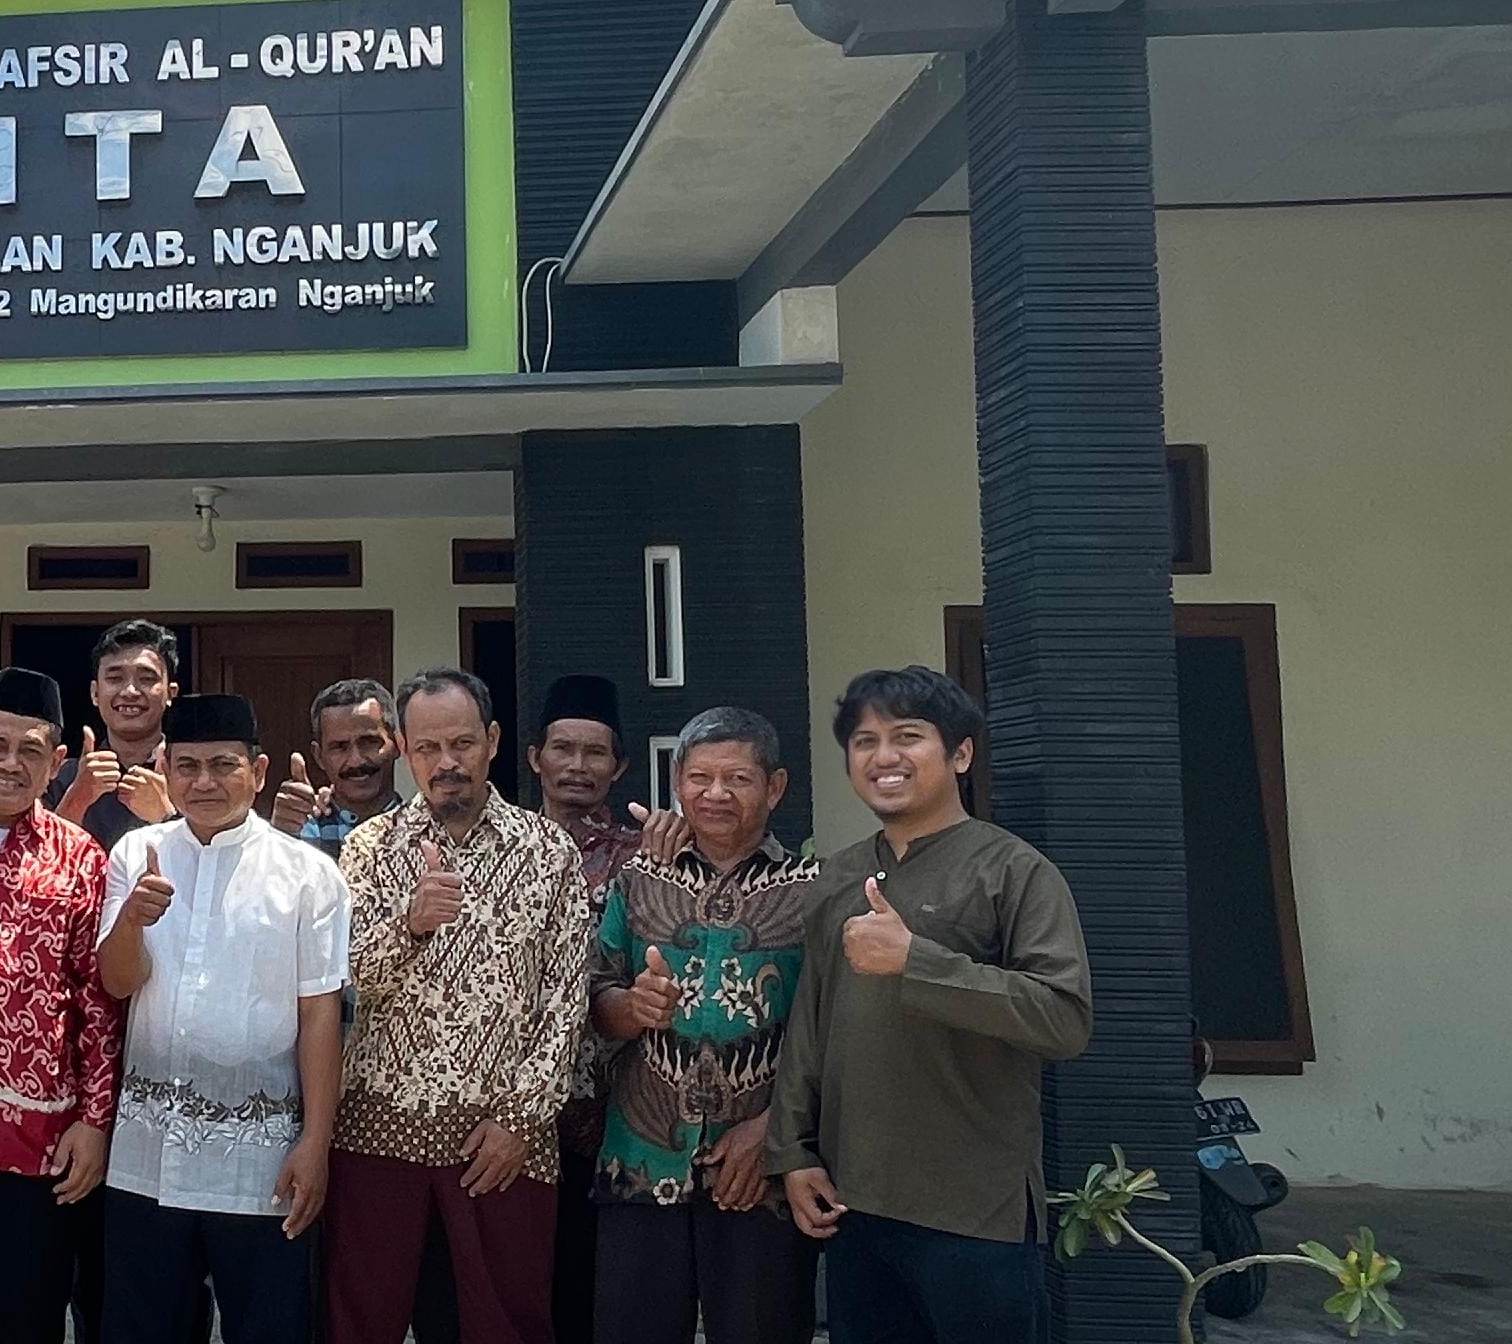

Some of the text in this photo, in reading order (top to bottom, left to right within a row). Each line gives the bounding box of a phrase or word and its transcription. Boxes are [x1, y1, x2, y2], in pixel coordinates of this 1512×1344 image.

[91, 230, 196, 270] KAB.
[212, 219, 439, 266] NGANJUK
[29, 281, 278, 320] Mangundikaran
[297, 274, 436, 313] Nganjuk
